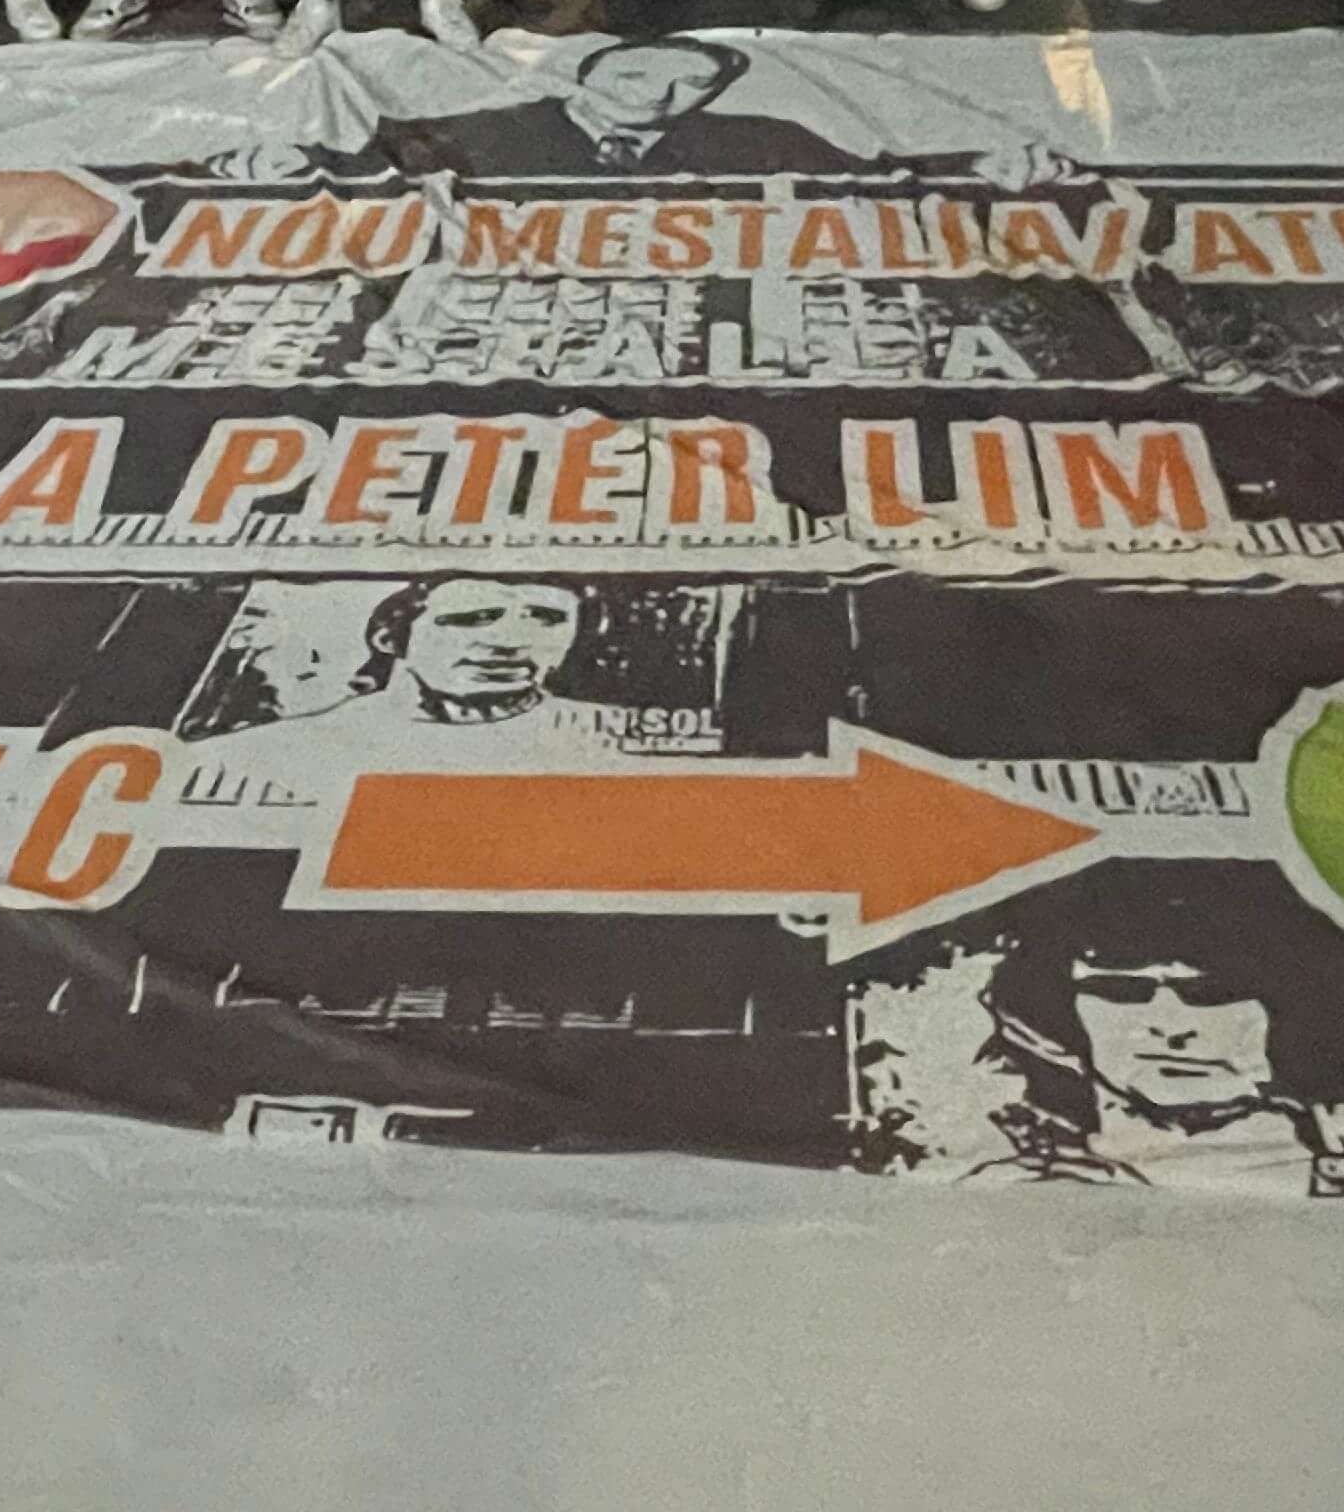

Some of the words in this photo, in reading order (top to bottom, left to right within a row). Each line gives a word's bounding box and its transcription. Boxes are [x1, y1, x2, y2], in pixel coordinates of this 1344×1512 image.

[162, 196, 425, 271] NOU
[187, 418, 758, 527] PETER
[864, 428, 1209, 532] LIM
